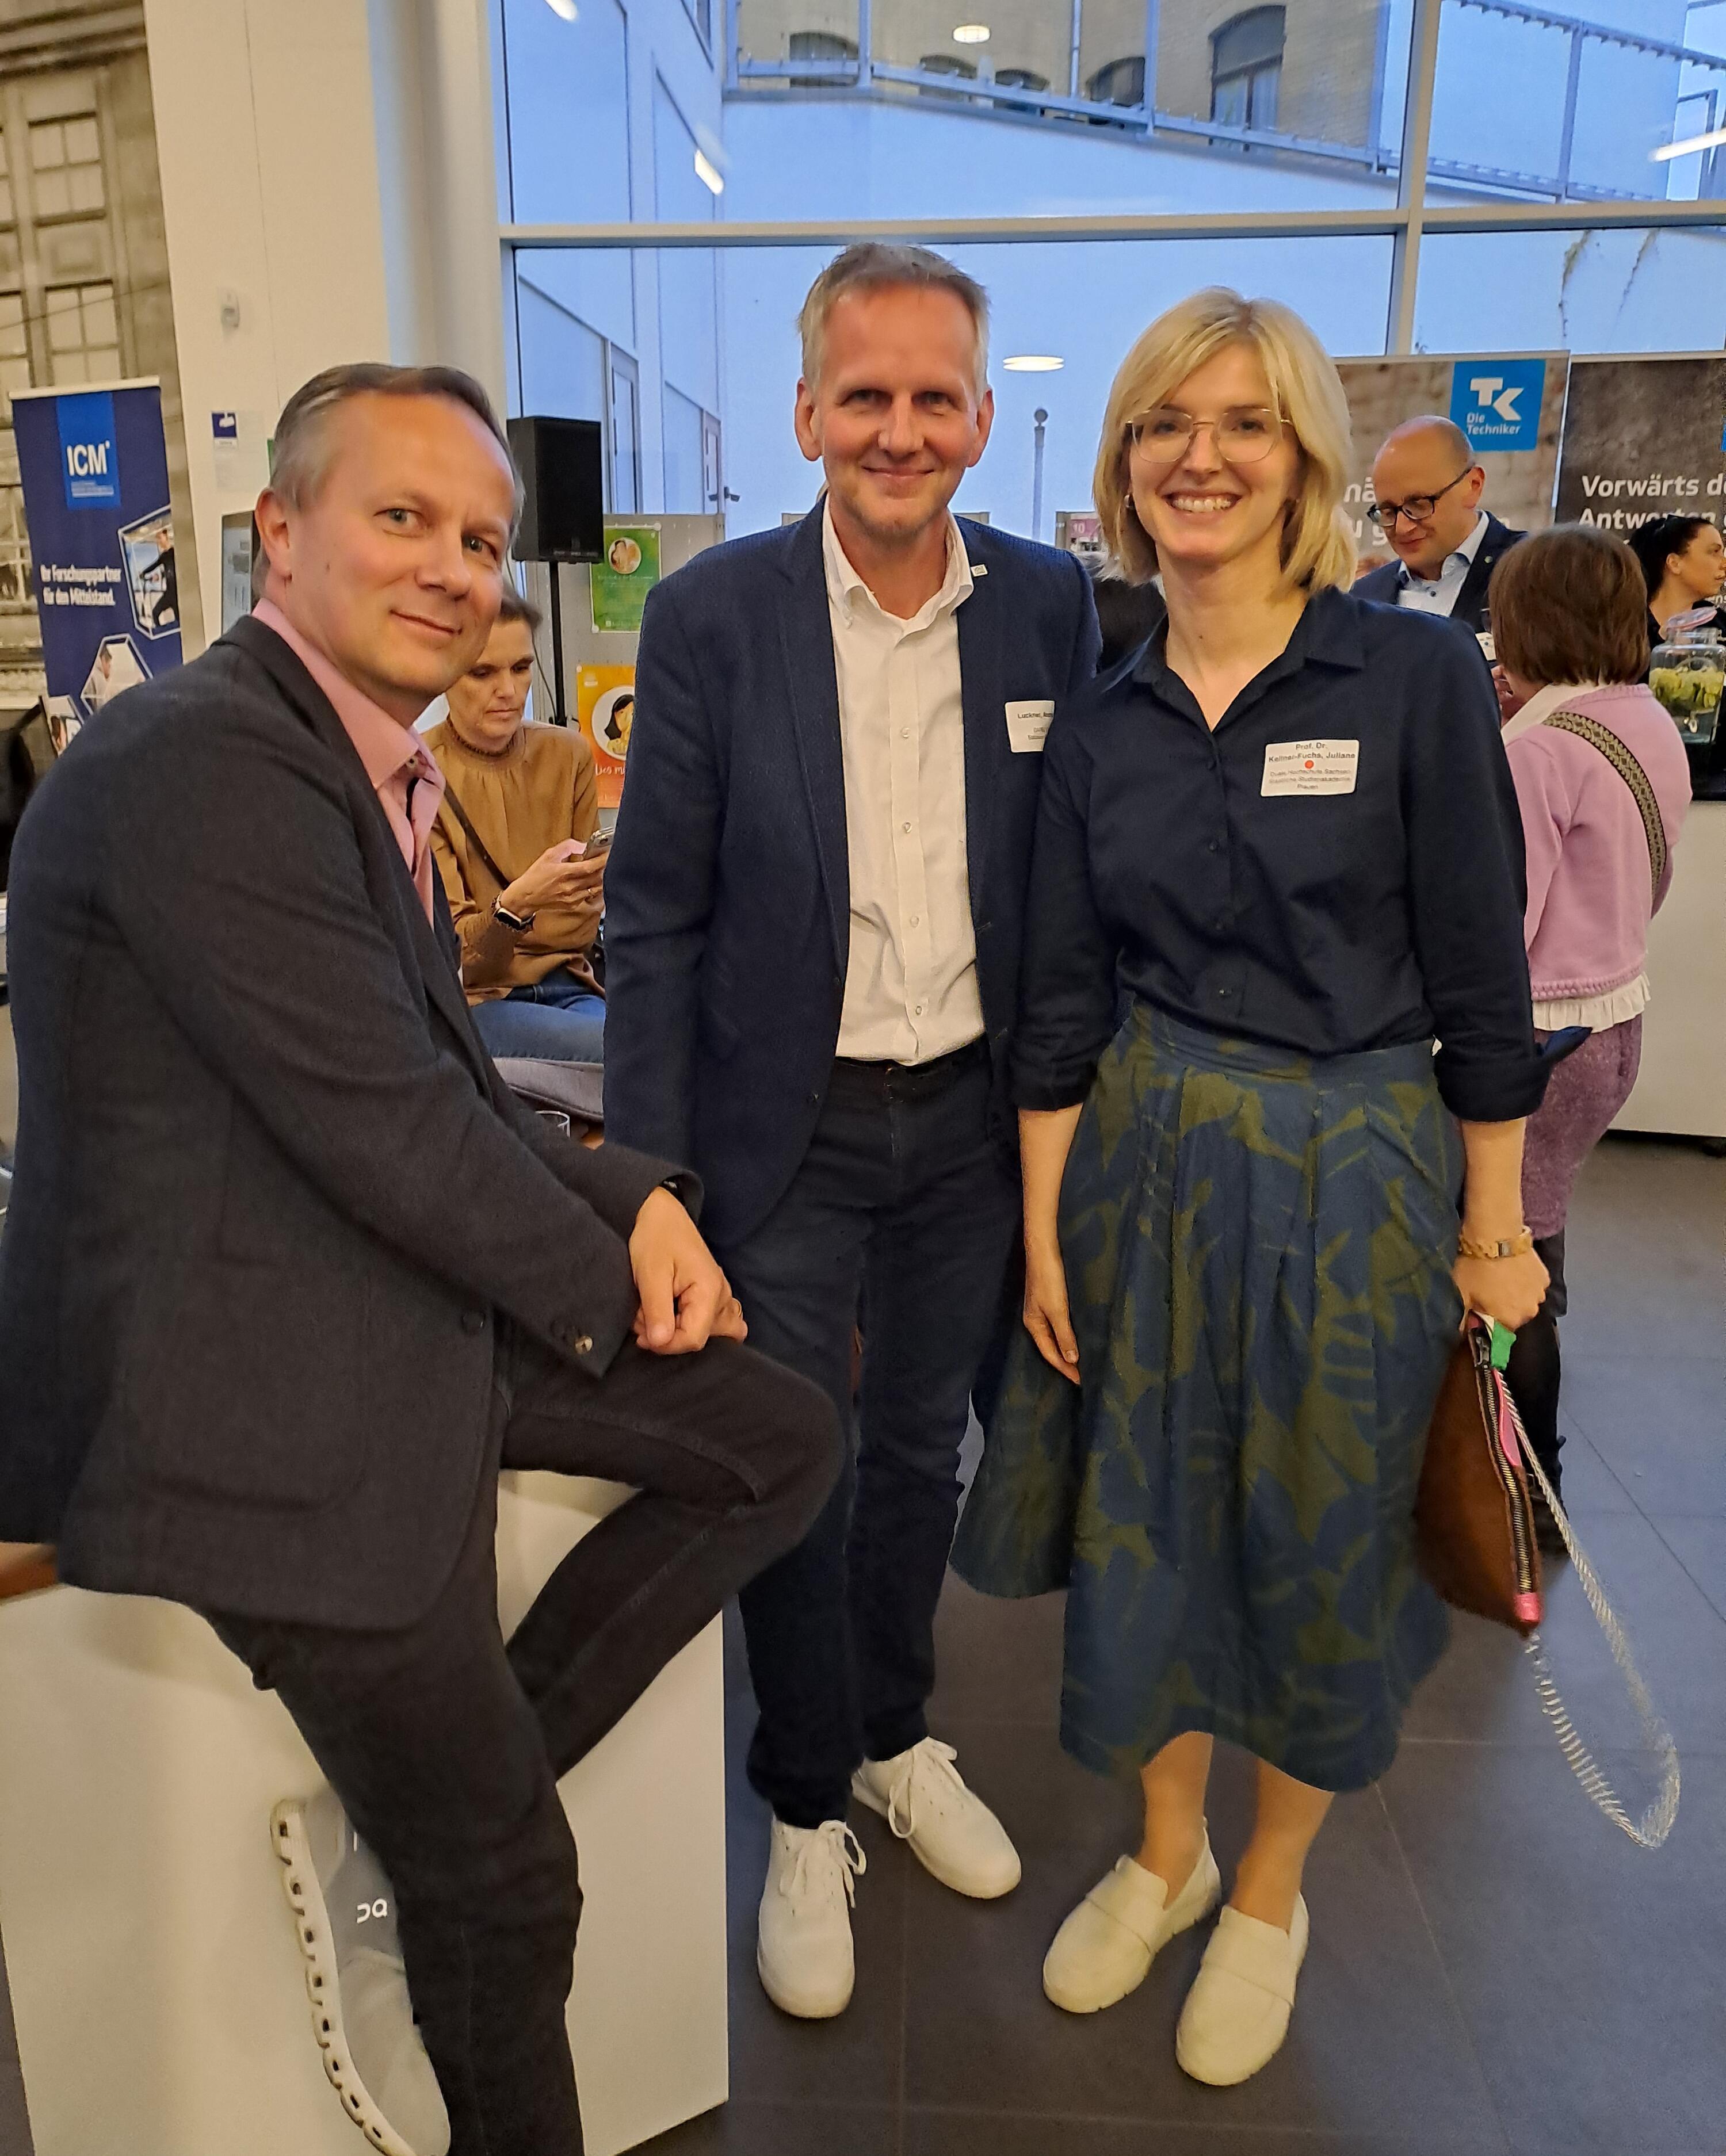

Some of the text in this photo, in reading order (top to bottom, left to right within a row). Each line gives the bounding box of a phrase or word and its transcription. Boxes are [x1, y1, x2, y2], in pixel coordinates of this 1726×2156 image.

[1467, 412, 1486, 423] Die
[1467, 423, 1521, 435] Techniker
[1582, 473, 1726, 498] Vorwärts d
